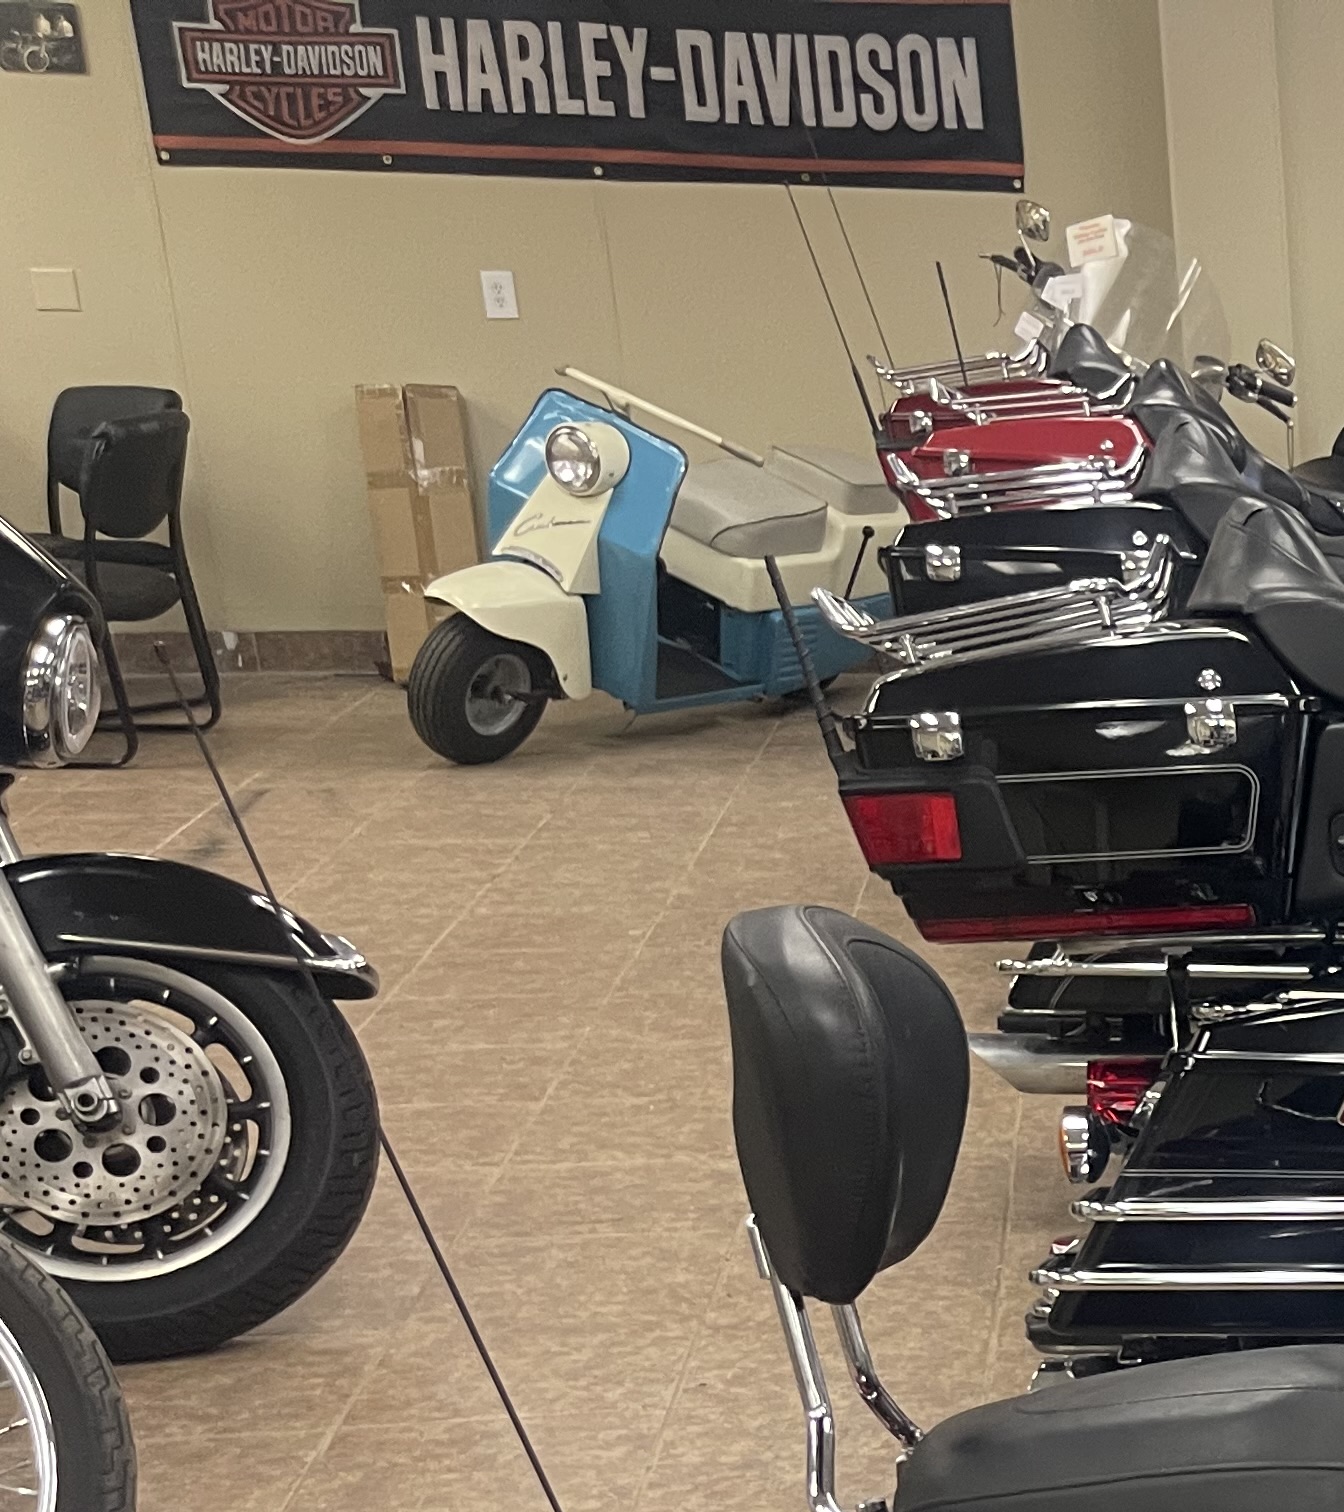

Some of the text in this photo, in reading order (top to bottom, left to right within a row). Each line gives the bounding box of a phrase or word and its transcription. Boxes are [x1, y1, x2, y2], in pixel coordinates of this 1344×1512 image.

[237, 1, 335, 33] MOTOR
[195, 40, 385, 77] HARLEY-DAVIDSON
[416, 15, 984, 132] HARLEY-DAVIDSON
[246, 85, 344, 128] CYCLES
